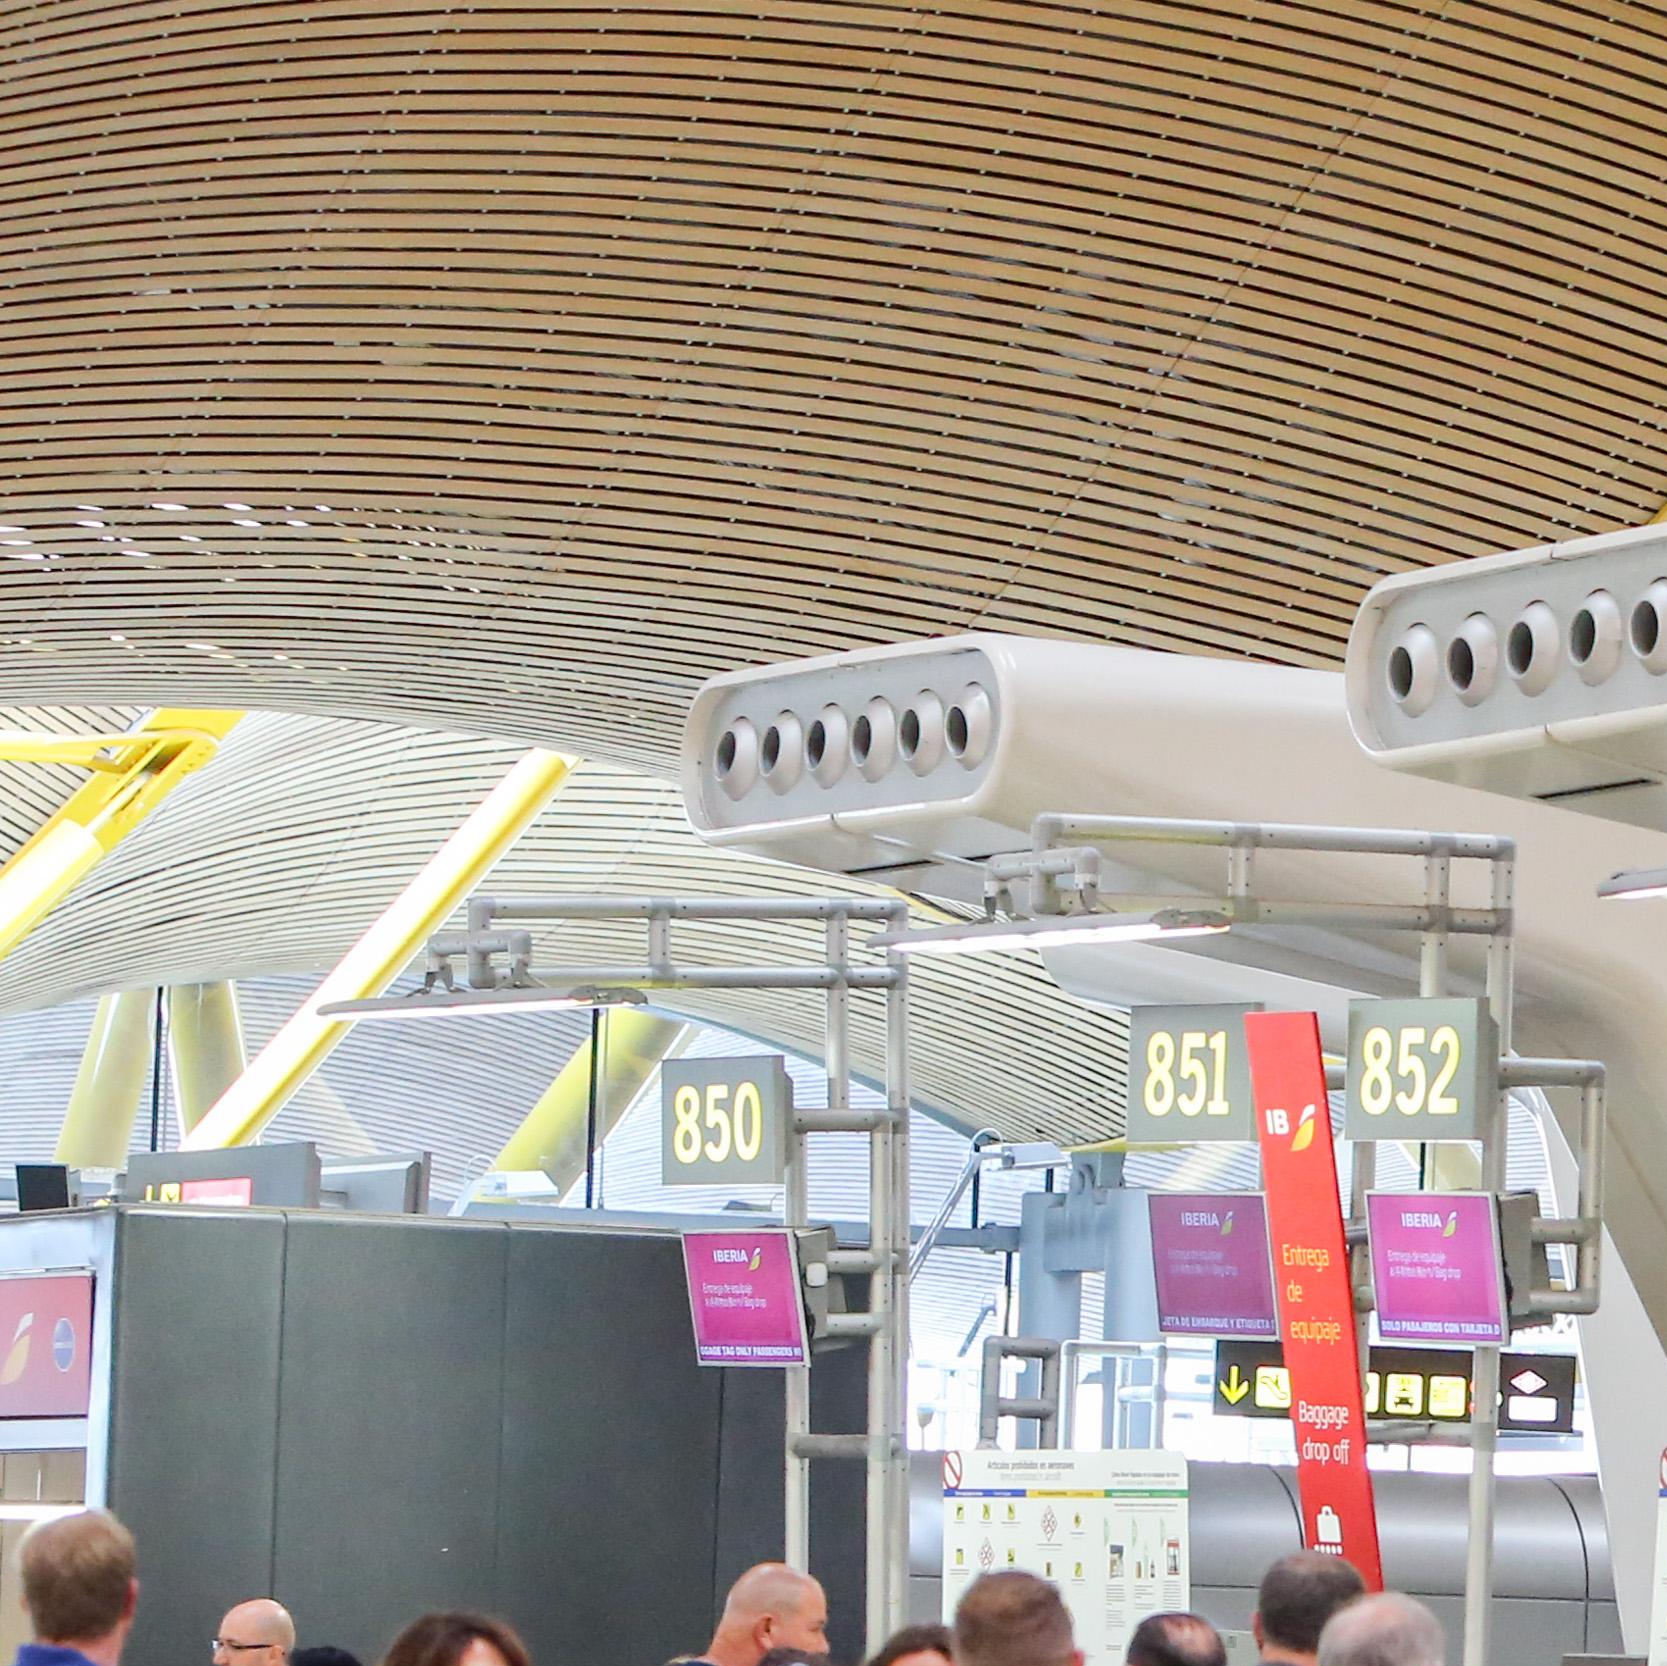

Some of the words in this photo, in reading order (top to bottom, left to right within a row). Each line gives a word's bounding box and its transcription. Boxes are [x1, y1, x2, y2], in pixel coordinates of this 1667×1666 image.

[1144, 1030, 1230, 1117] 851
[1360, 1025, 1460, 1116] 852
[673, 1081, 762, 1163] 850
[1265, 1109, 1289, 1135] IB
[1181, 1211, 1219, 1227] IBERIA
[1401, 1213, 1442, 1228] IBERIA
[713, 1249, 748, 1264] IBERIA
[1283, 1244, 1329, 1272] Entrega
[1287, 1280, 1303, 1303] de
[1290, 1316, 1341, 1345] equipaje
[1299, 1400, 1349, 1430] Baggage
[1303, 1439, 1331, 1465] drop
[1333, 1438, 1350, 1465] off
